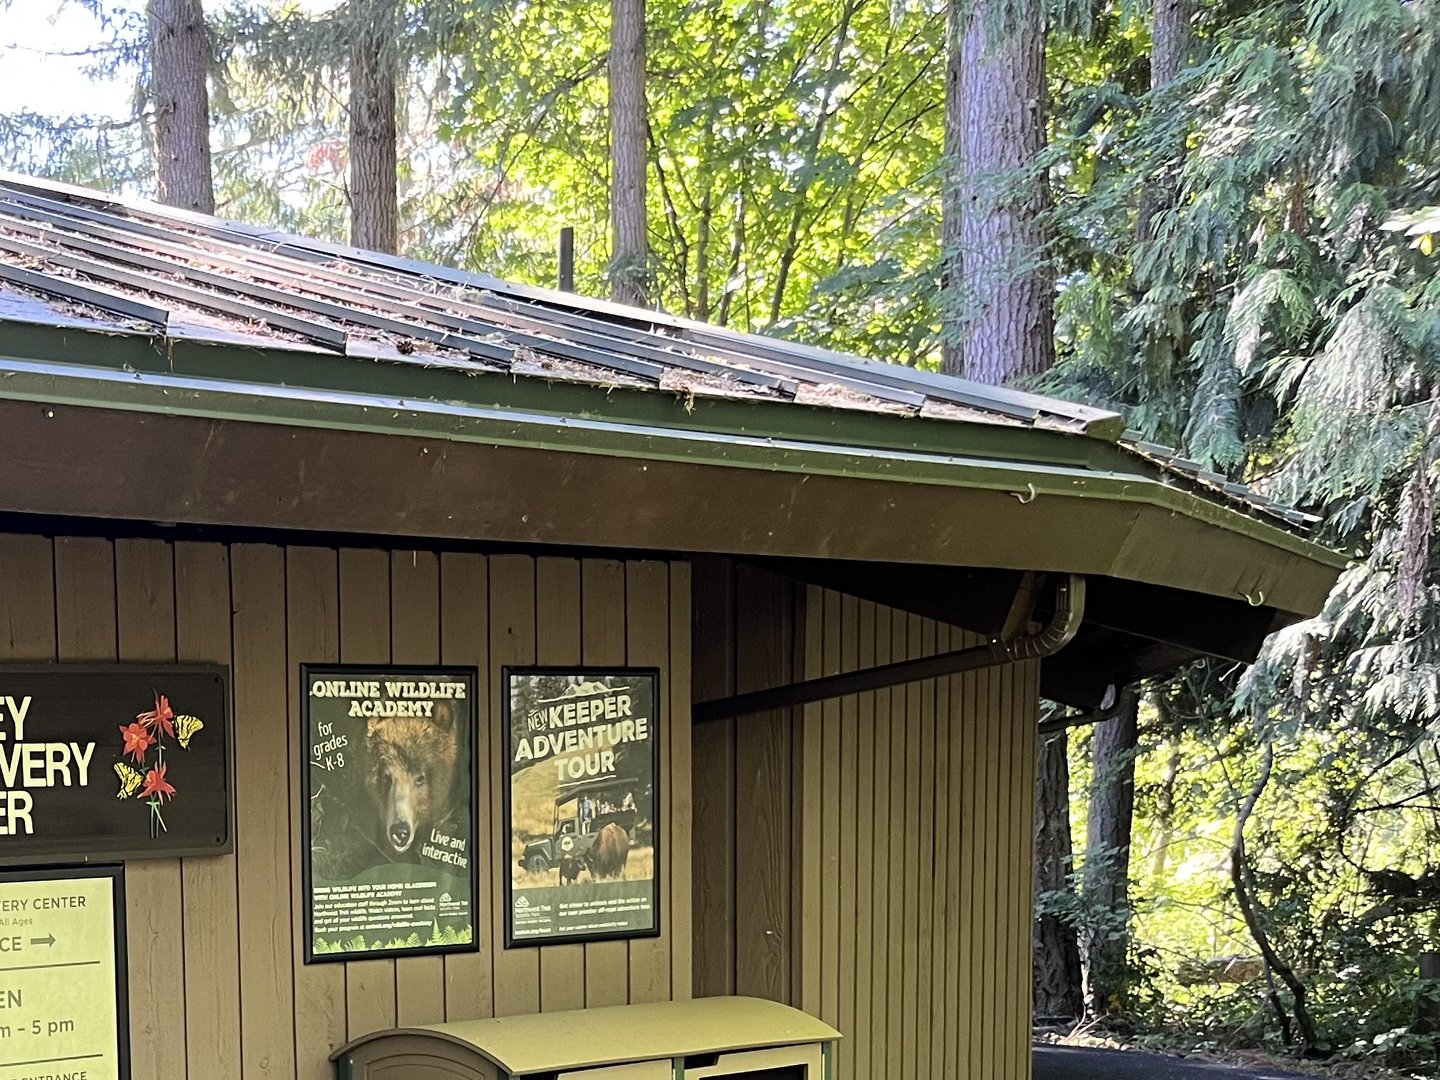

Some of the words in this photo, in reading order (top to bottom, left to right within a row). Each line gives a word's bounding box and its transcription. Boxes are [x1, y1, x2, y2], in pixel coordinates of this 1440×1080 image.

[312, 681, 381, 698] ONLINE
[384, 681, 466, 699] WILDLIFE
[348, 700, 434, 718] ACADEMY
[527, 709, 549, 732] NEW
[549, 695, 632, 730] KEEPER
[318, 721, 333, 736] for
[313, 733, 348, 760] grades
[514, 718, 648, 762] ADVENTURE
[325, 753, 345, 771] K-8
[554, 751, 615, 781] TOUR
[430, 828, 450, 844] Live
[451, 836, 466, 852] and
[422, 843, 468, 869] interactive
[33, 896, 87, 910] CENTER
[12, 917, 33, 928] Ages
[32, 1020, 42, 1035] 5
[48, 1019, 75, 1037] pm
